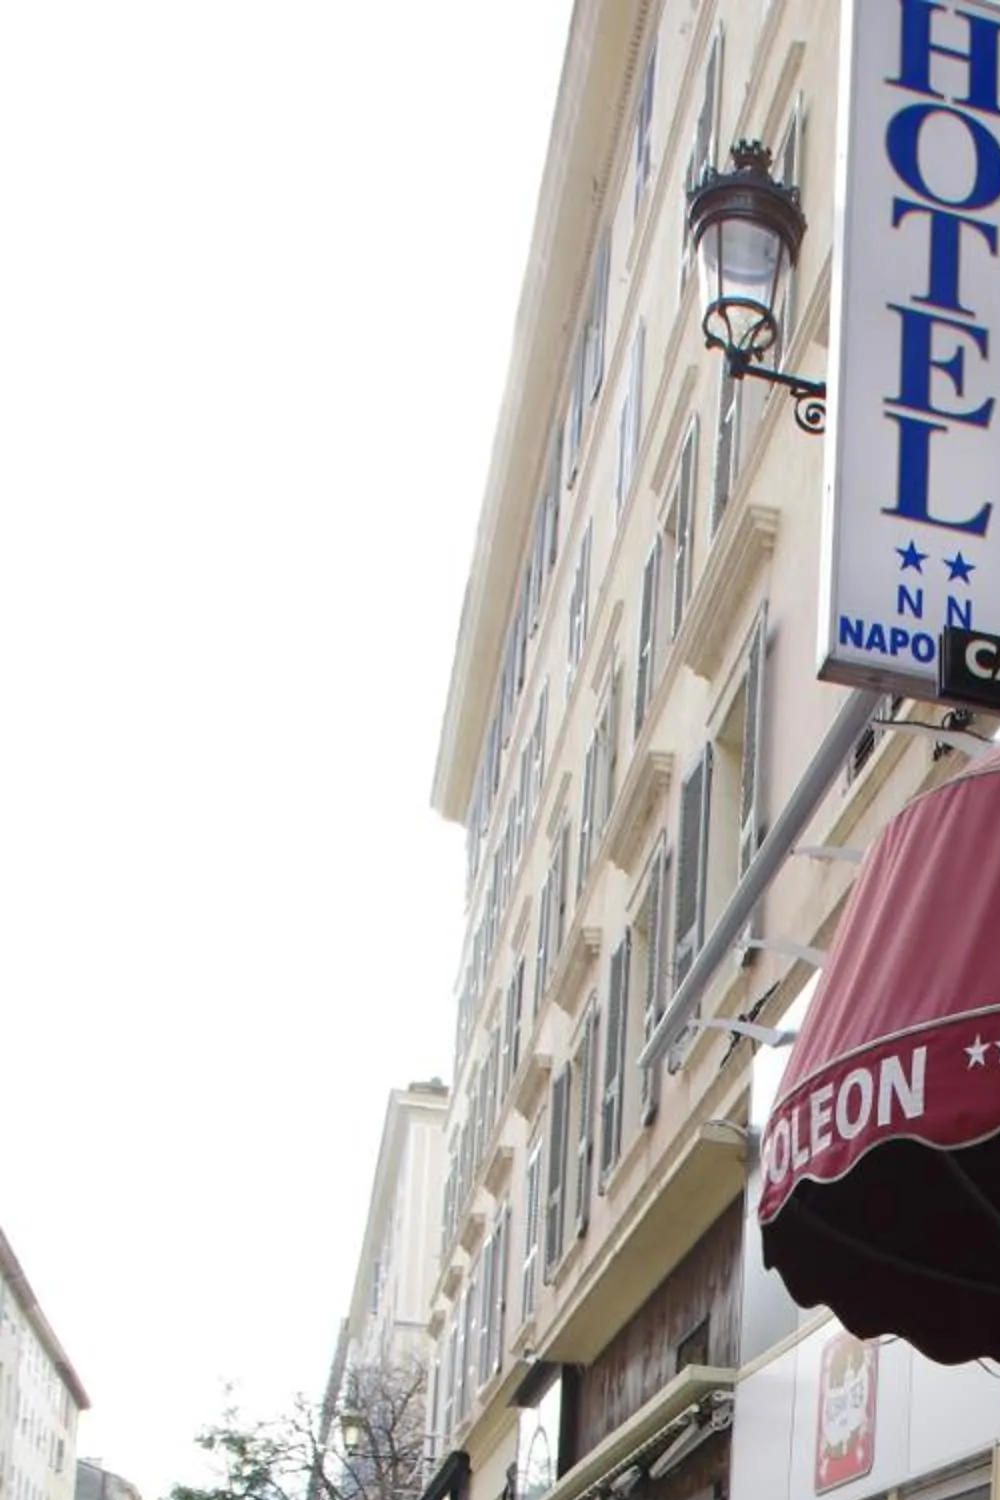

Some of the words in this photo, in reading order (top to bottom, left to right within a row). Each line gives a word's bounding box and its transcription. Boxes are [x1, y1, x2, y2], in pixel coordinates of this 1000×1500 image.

[897, 584, 923, 620] N
[946, 596, 972, 633] N
[839, 615, 935, 664] NAPO
